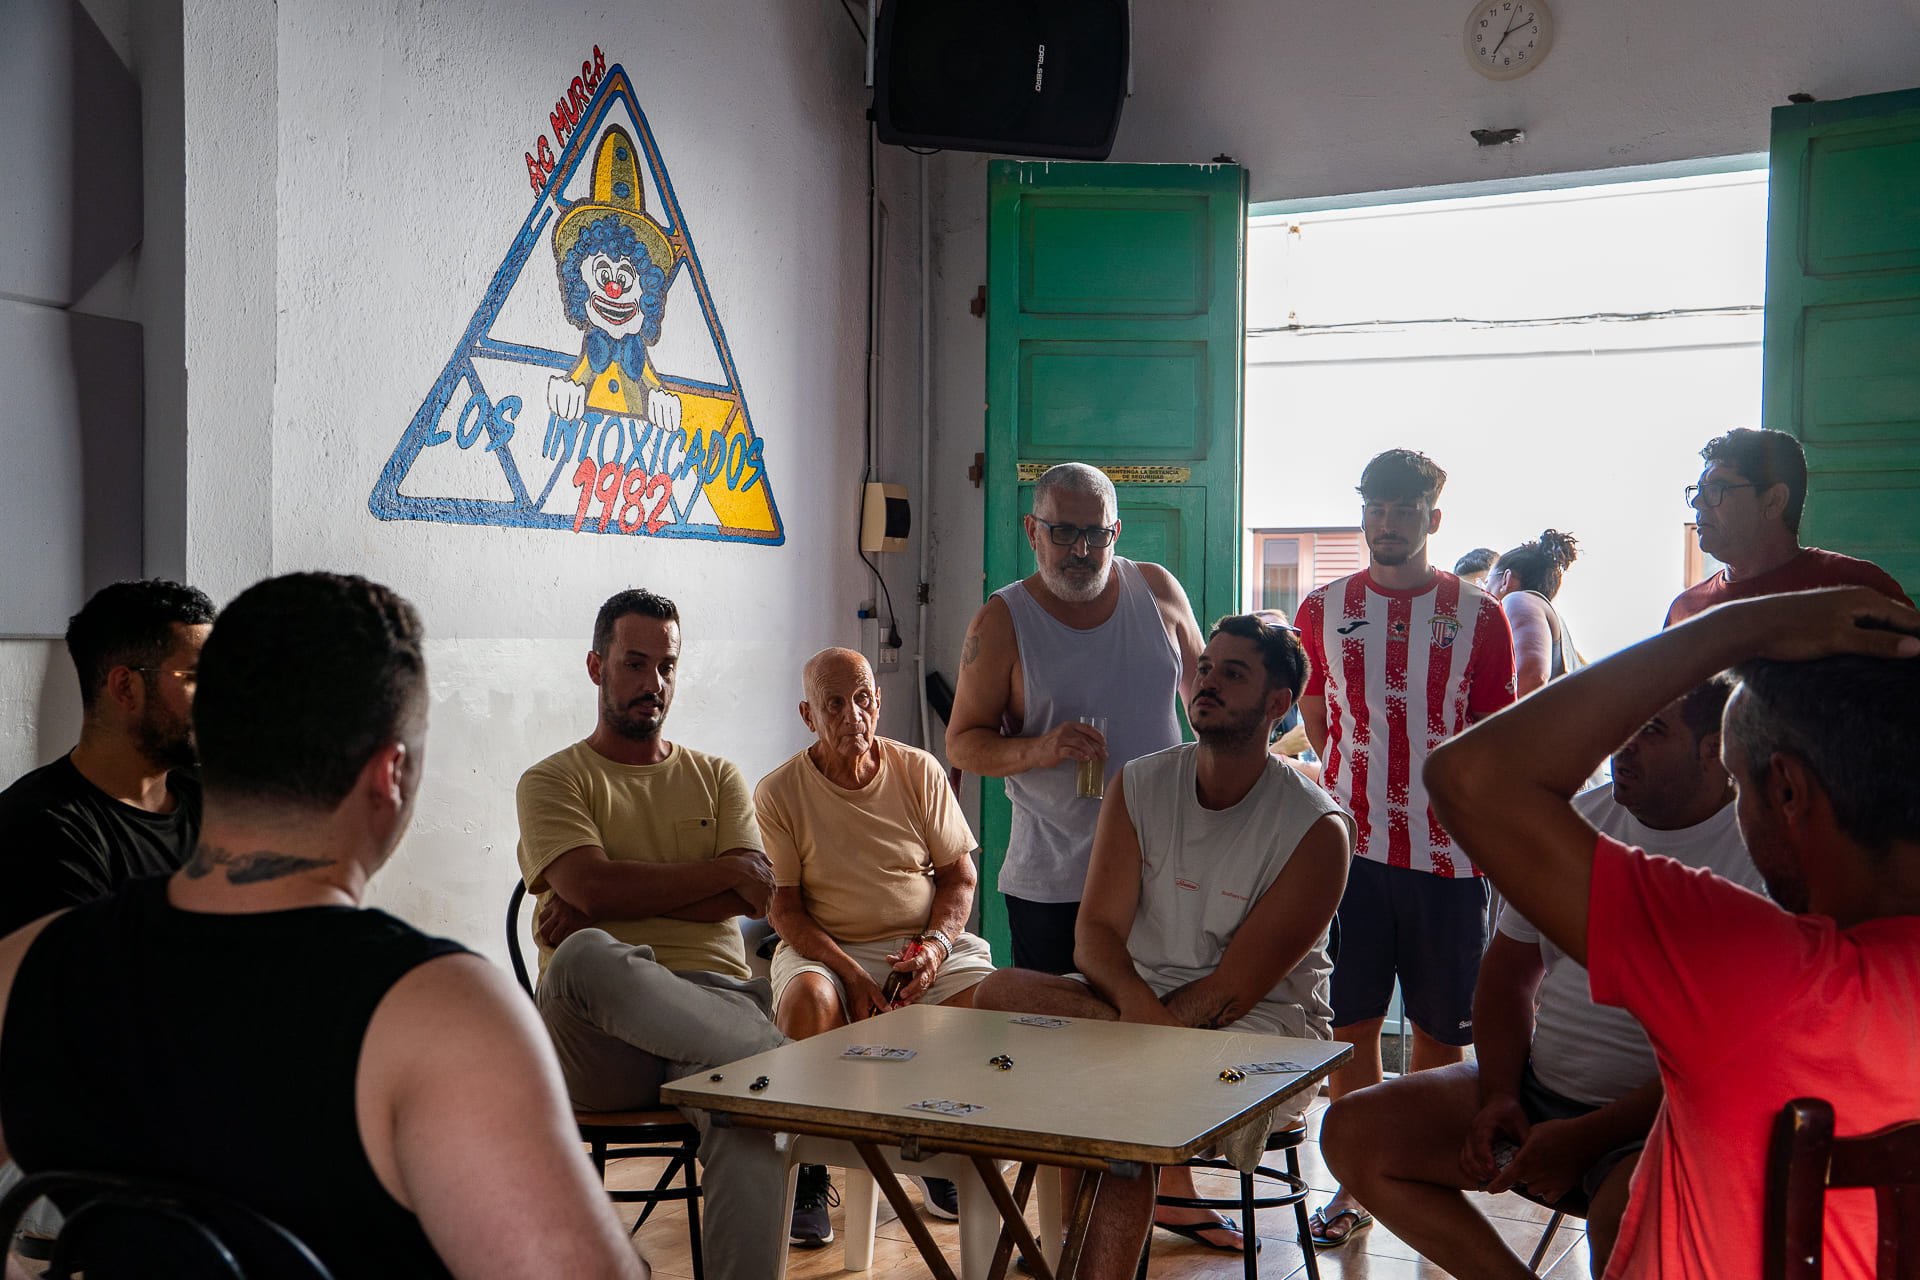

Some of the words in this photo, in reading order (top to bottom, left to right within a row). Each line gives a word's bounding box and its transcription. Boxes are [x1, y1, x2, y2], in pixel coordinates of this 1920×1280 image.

[1502, 2, 1511, 11] 12
[1489, 8, 1497, 17] 11
[1528, 12, 1534, 21] 2
[1480, 19, 1489, 28] 10
[1531, 25, 1538, 34] 3
[1476, 34, 1483, 42] 9
[1528, 40, 1534, 48] 4
[1480, 47, 1486, 55] 8
[1518, 51, 1525, 60] 5
[1490, 55, 1496, 63] 7
[1504, 57, 1510, 66] 6
[525, 134, 556, 199] AC
[549, 44, 607, 149] MURGA
[423, 391, 523, 453] LOS
[542, 411, 765, 493] INTOXICADOS
[572, 456, 673, 535] 1982
